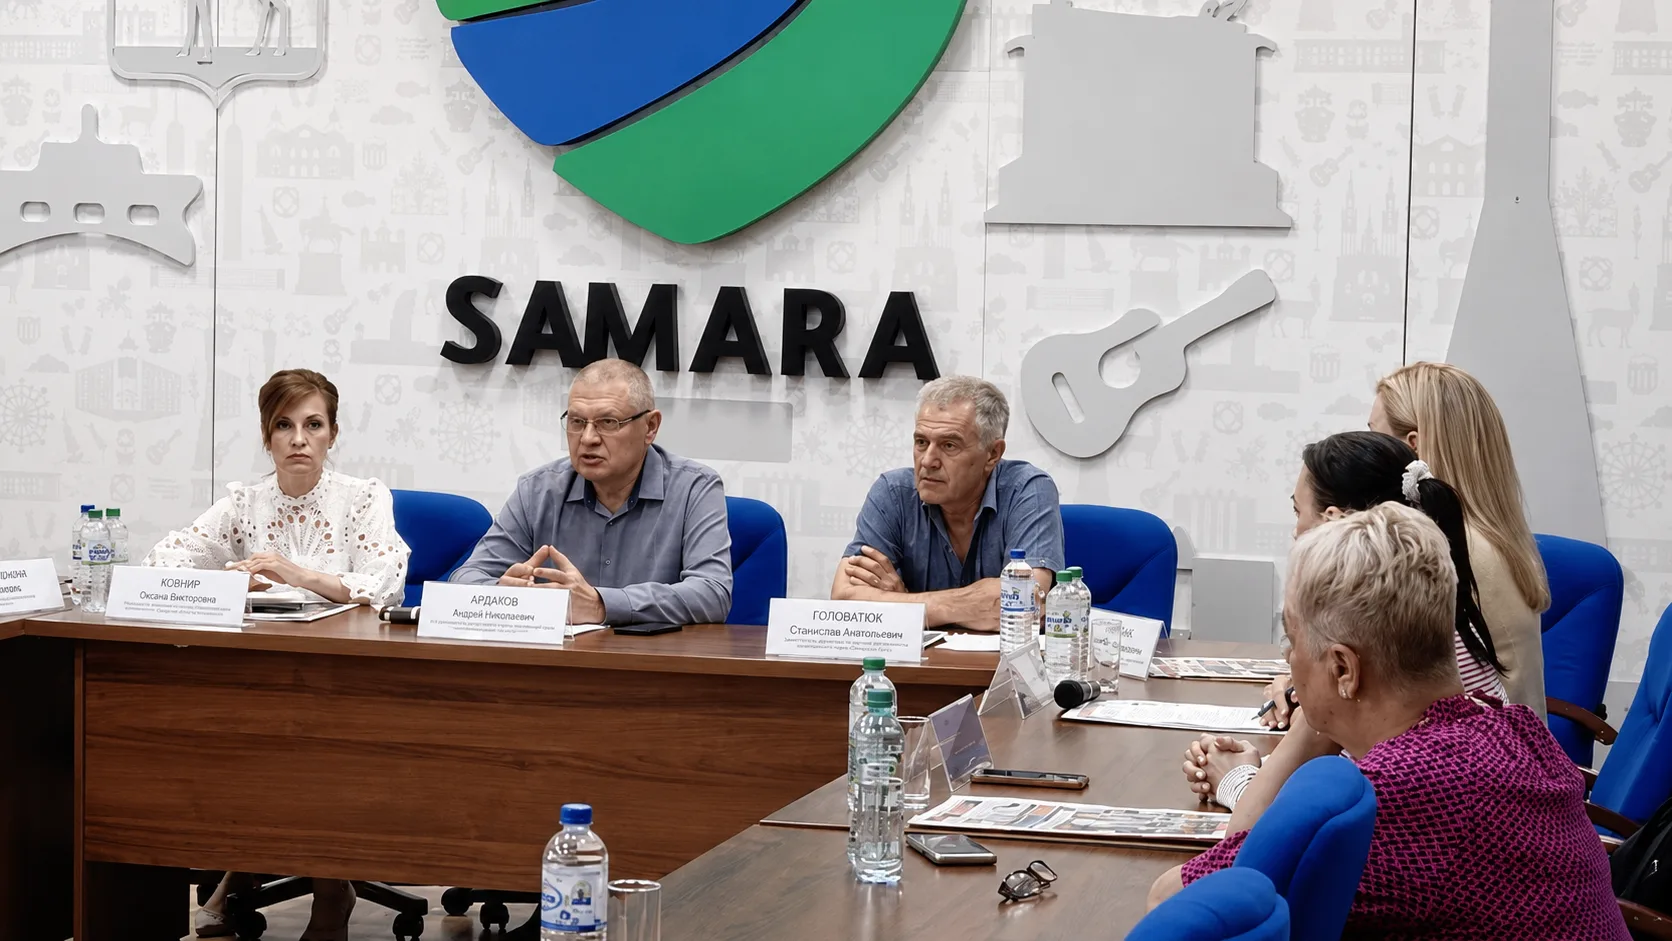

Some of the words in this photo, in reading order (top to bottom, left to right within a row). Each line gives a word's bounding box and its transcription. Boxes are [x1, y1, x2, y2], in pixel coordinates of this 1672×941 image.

[440, 275, 940, 380] SAMARA
[160, 578, 201, 589] КОВНИР
[139, 591, 169, 601] Оксана
[170, 593, 217, 604] Викторовна
[470, 595, 519, 607] АРДАКОВ
[452, 608, 483, 620] Андрей
[484, 610, 535, 622] Николаевич
[812, 610, 884, 624] ГОЛОВАТЮК
[789, 624, 841, 637] Станислав
[842, 628, 903, 640] Анатольевич
